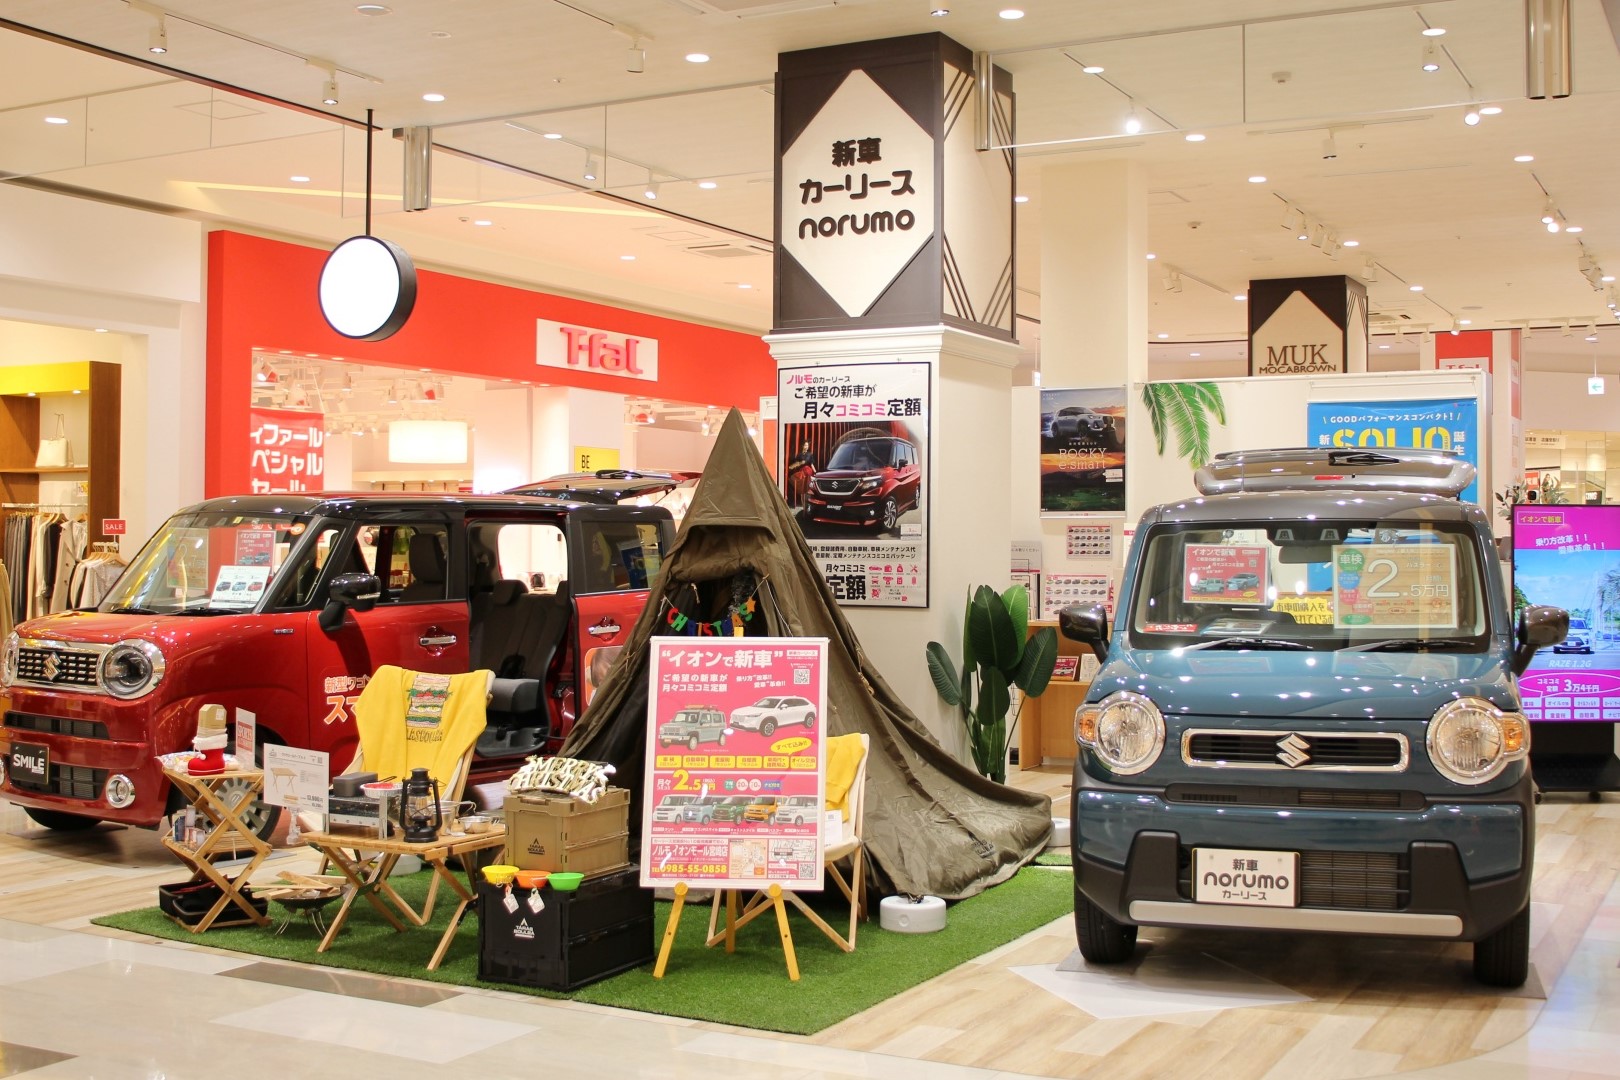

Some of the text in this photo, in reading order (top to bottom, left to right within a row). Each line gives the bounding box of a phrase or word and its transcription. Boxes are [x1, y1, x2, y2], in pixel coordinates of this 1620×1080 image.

[831, 137, 882, 167] 新車
[799, 169, 916, 205] カーリース
[798, 209, 916, 241] norumo
[559, 327, 644, 375] T-fal
[1266, 344, 1329, 366] MUK
[1259, 364, 1337, 374] MOCABROWN
[786, 374, 851, 385] ノルモのカーリース
[794, 384, 878, 400] ご希望の新車が
[803, 398, 922, 420] 月々コミコミ定額
[1058, 447, 1107, 459] ROCKY
[581, 454, 591, 469] BE
[105, 523, 124, 531] SALE
[1339, 554, 1363, 565] 車検
[825, 563, 866, 573] 月々コミコミ
[1548, 659, 1571, 668] RAZE
[662, 673, 729, 683] ご希望の新車が
[662, 683, 728, 692] 月々コミコミ定額
[13, 753, 45, 770] SMILE
[660, 864, 727, 874] 0985-55-0858
[1231, 858, 1259, 872] 新車
[1203, 871, 1290, 890] norumo
[1221, 890, 1267, 901] カーリース
